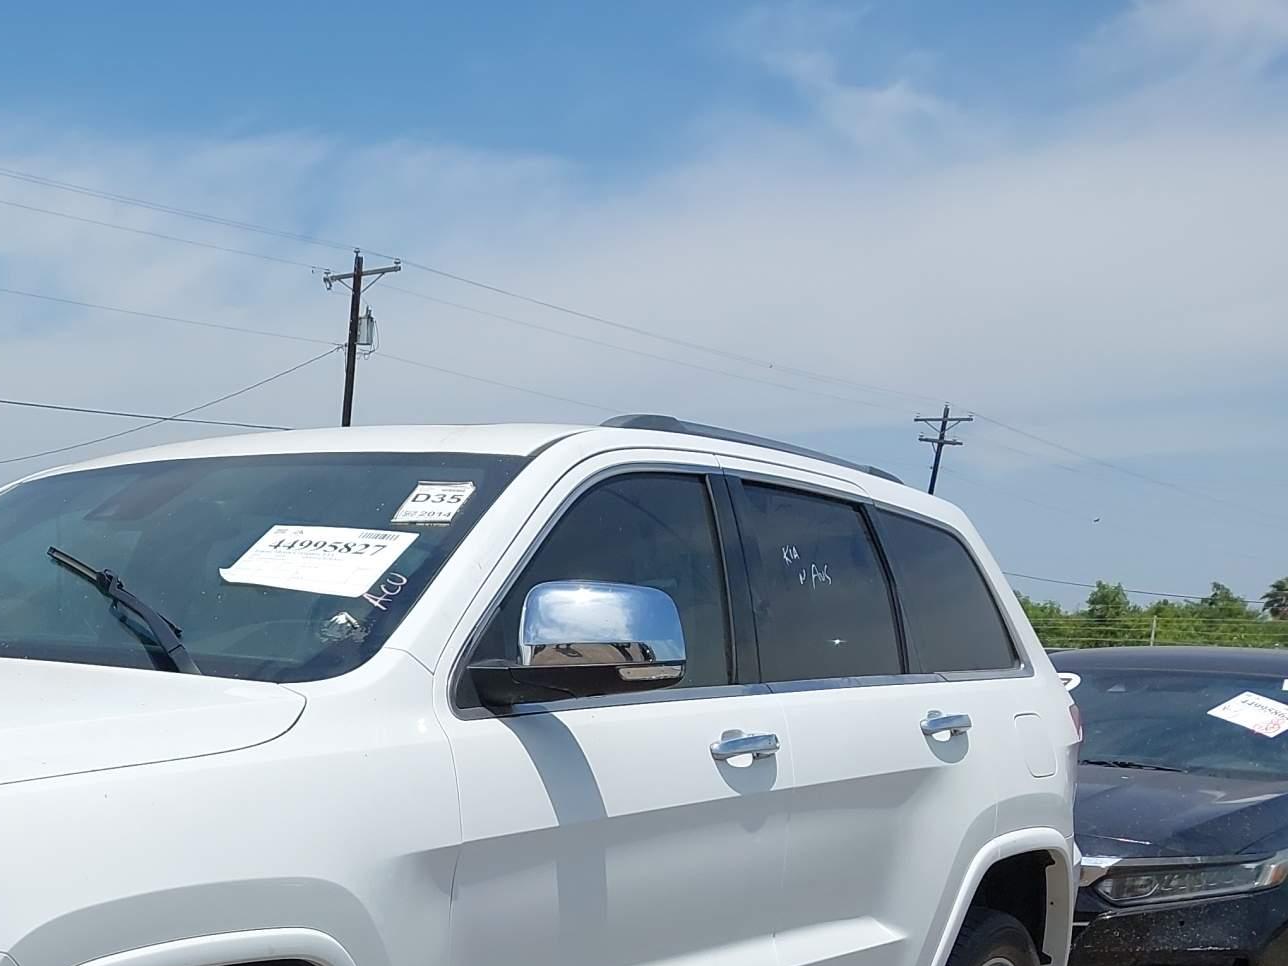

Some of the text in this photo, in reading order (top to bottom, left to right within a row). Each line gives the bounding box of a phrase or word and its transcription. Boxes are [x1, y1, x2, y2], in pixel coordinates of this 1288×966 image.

[411, 493, 464, 503] D35
[418, 511, 452, 519] 2014
[268, 538, 388, 557] 44995827
